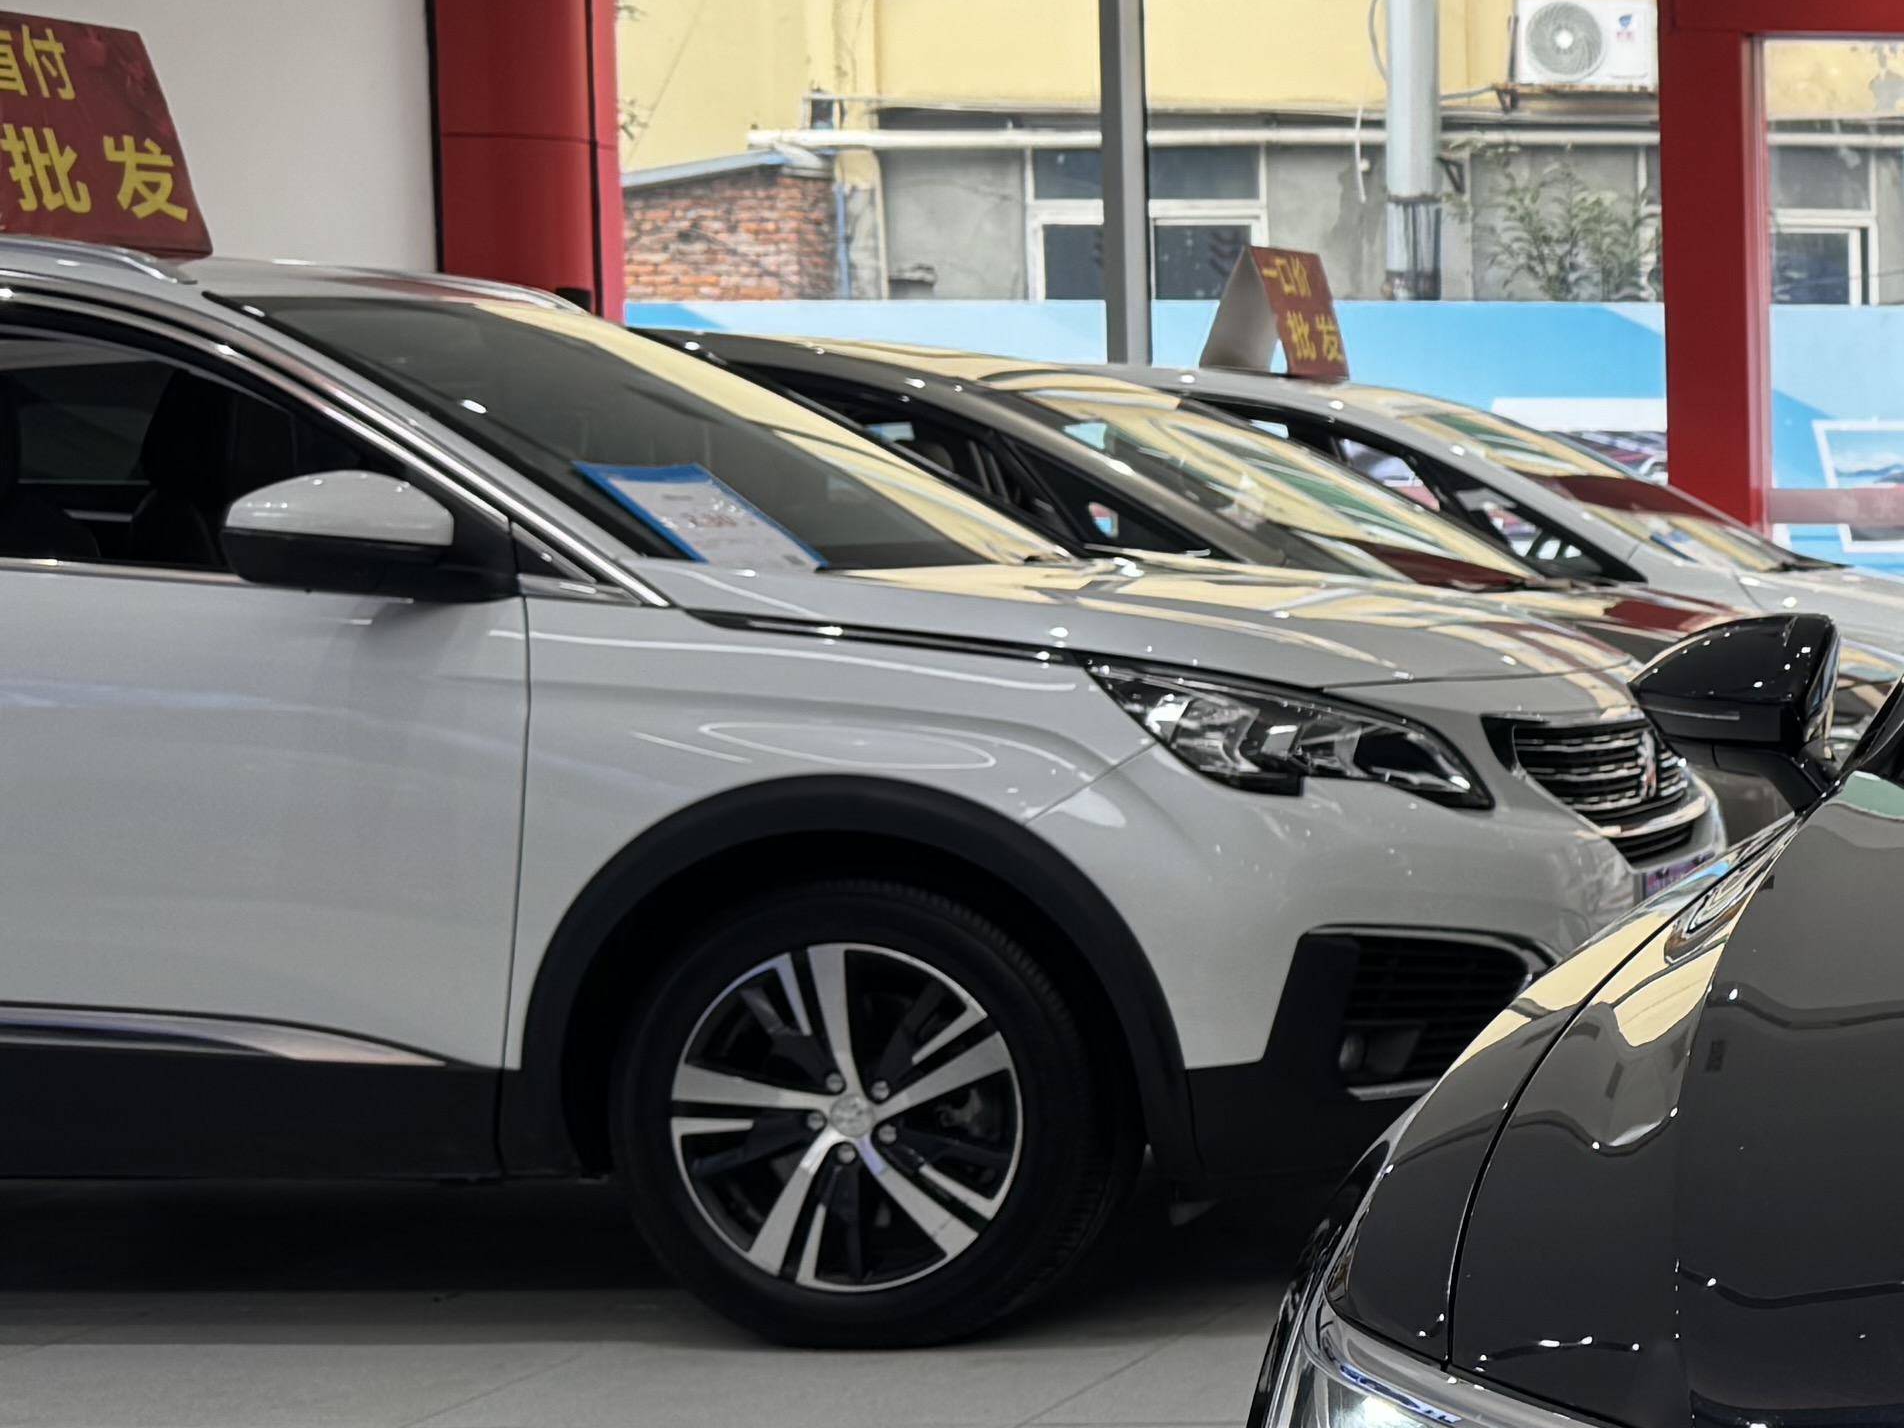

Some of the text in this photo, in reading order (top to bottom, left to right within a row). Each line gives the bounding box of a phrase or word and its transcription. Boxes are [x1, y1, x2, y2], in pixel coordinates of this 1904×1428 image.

[0, 124, 188, 222] 批发
[1262, 256, 1311, 297] 一口价
[1286, 311, 1345, 362] 批发
